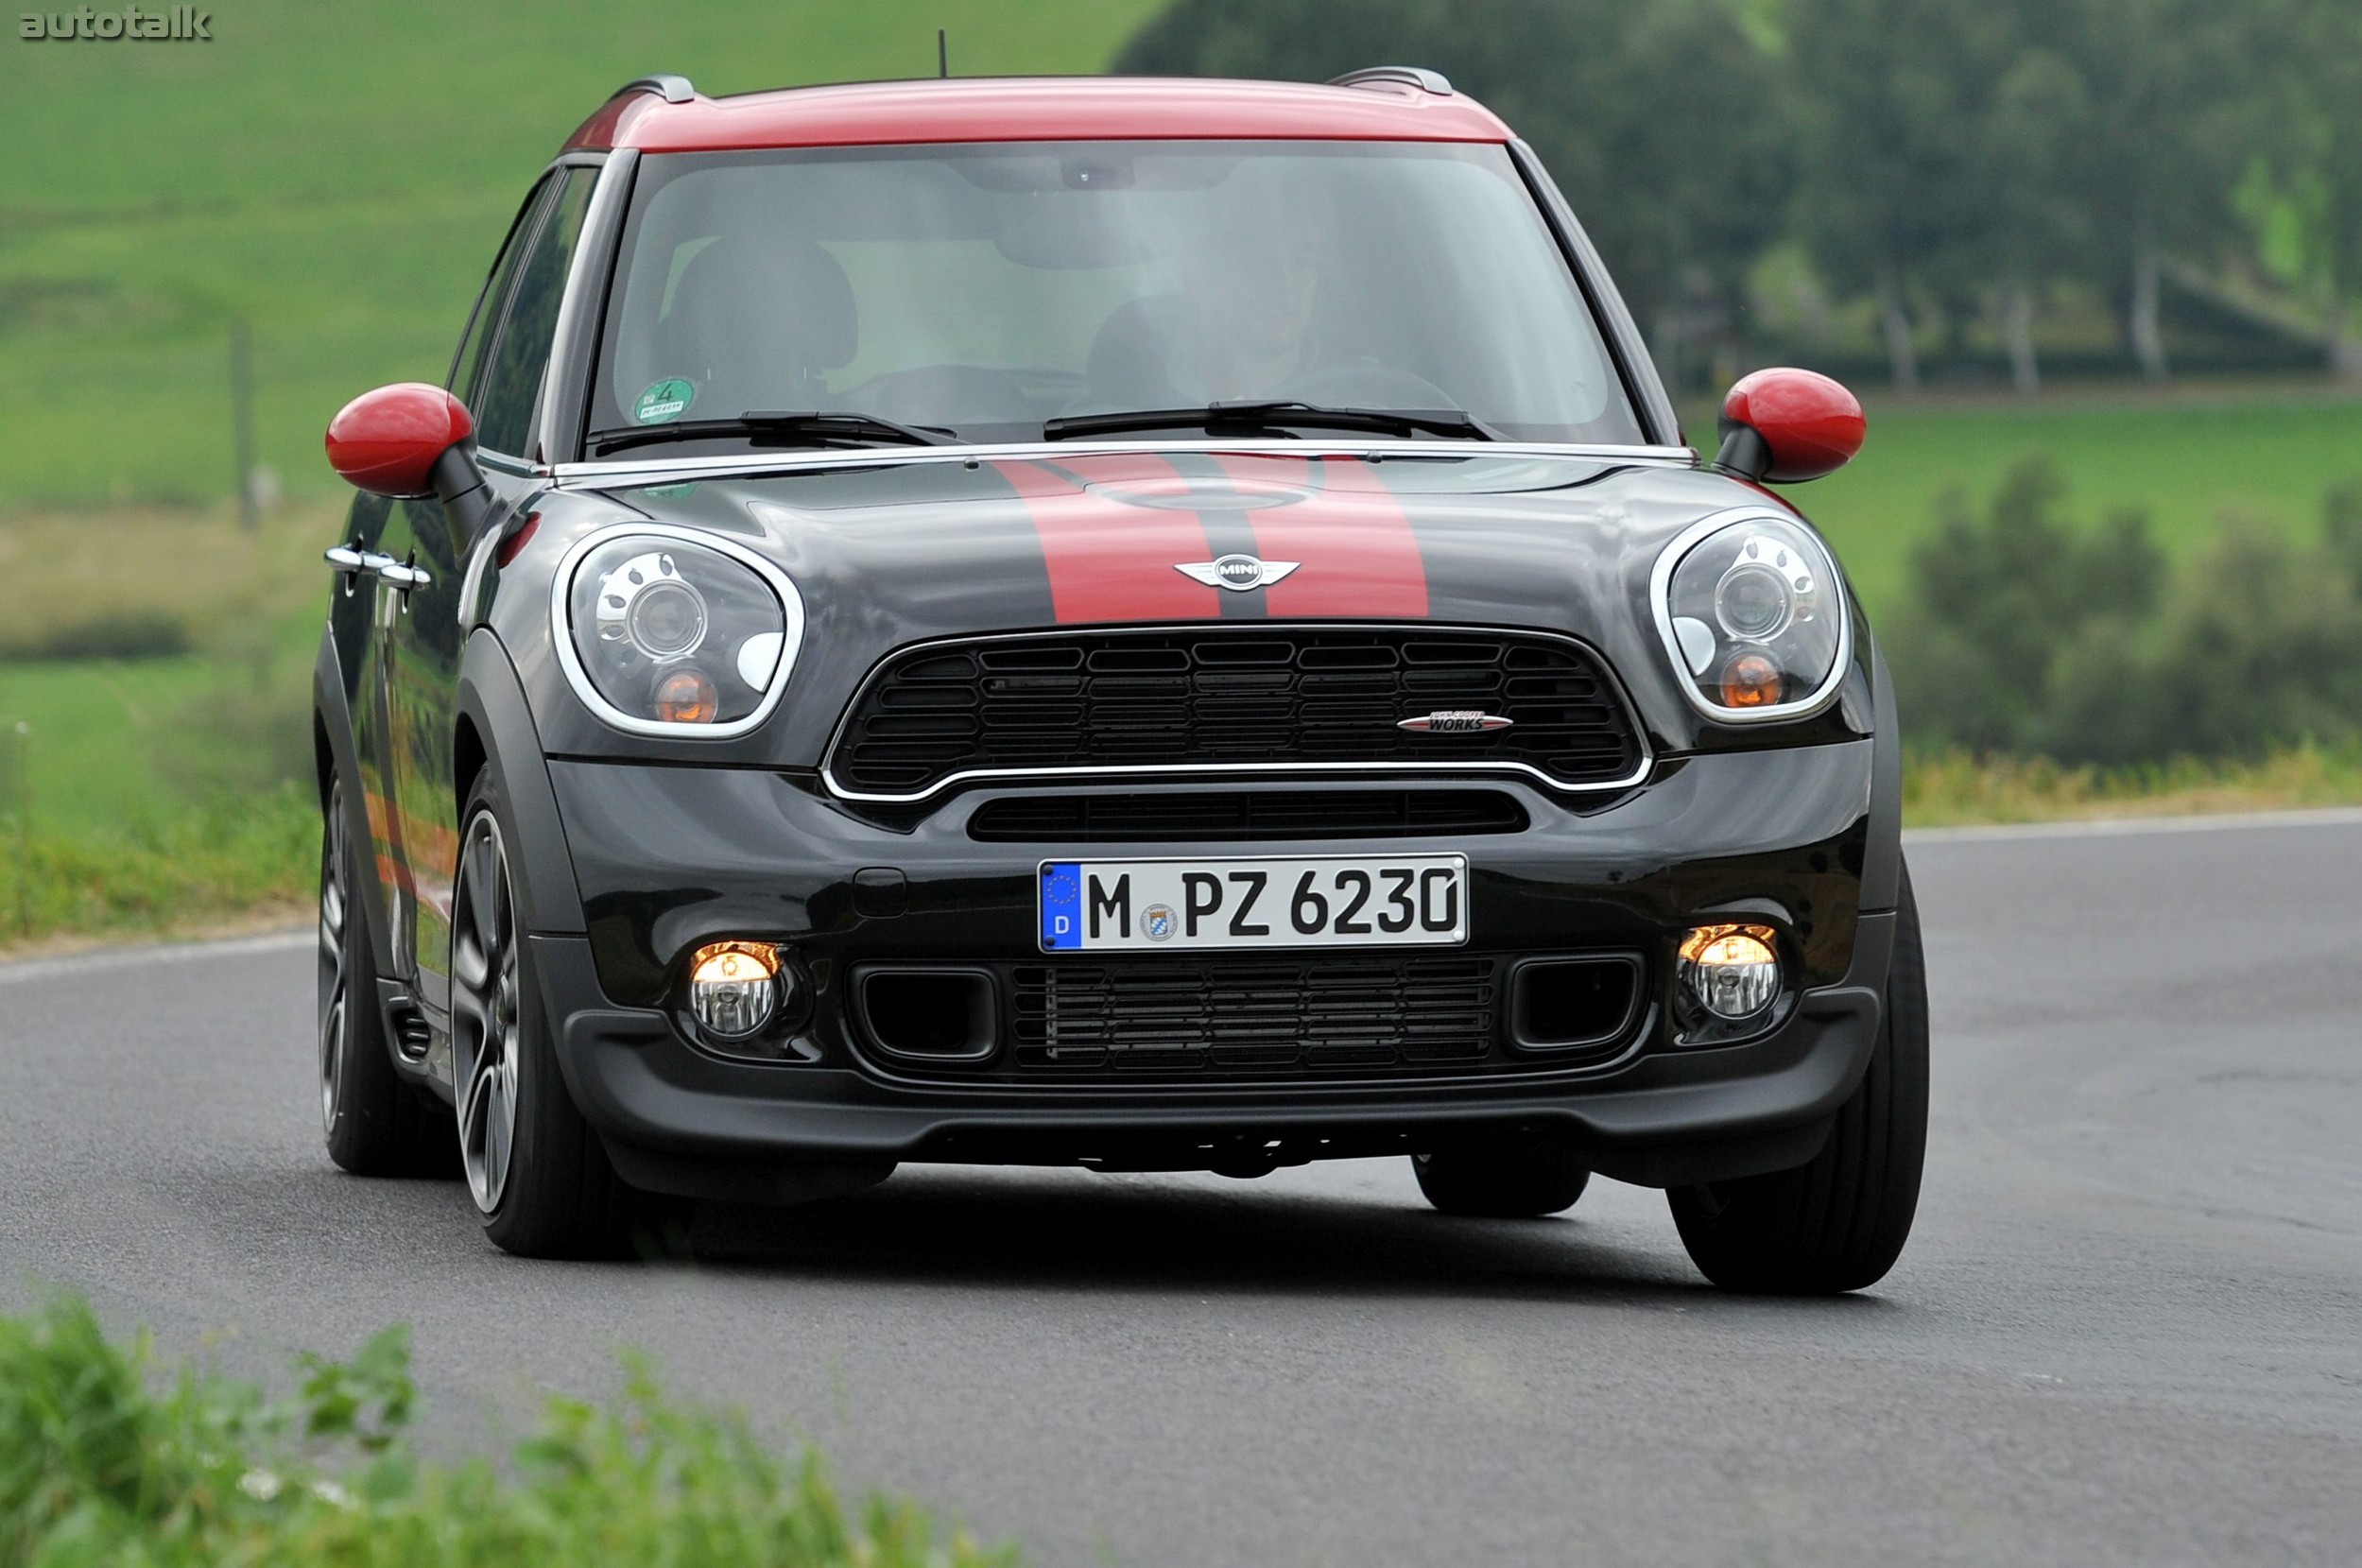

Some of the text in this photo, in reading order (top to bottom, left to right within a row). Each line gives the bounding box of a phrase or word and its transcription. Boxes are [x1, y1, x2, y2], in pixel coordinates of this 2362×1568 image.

[657, 383, 672, 402] 4
[1219, 564, 1258, 576] MINI
[1430, 719, 1484, 731] WORKS
[1089, 873, 1130, 939] M
[1181, 871, 1269, 937] PZ
[1291, 868, 1457, 935] 6230
[1055, 916, 1070, 934] D
